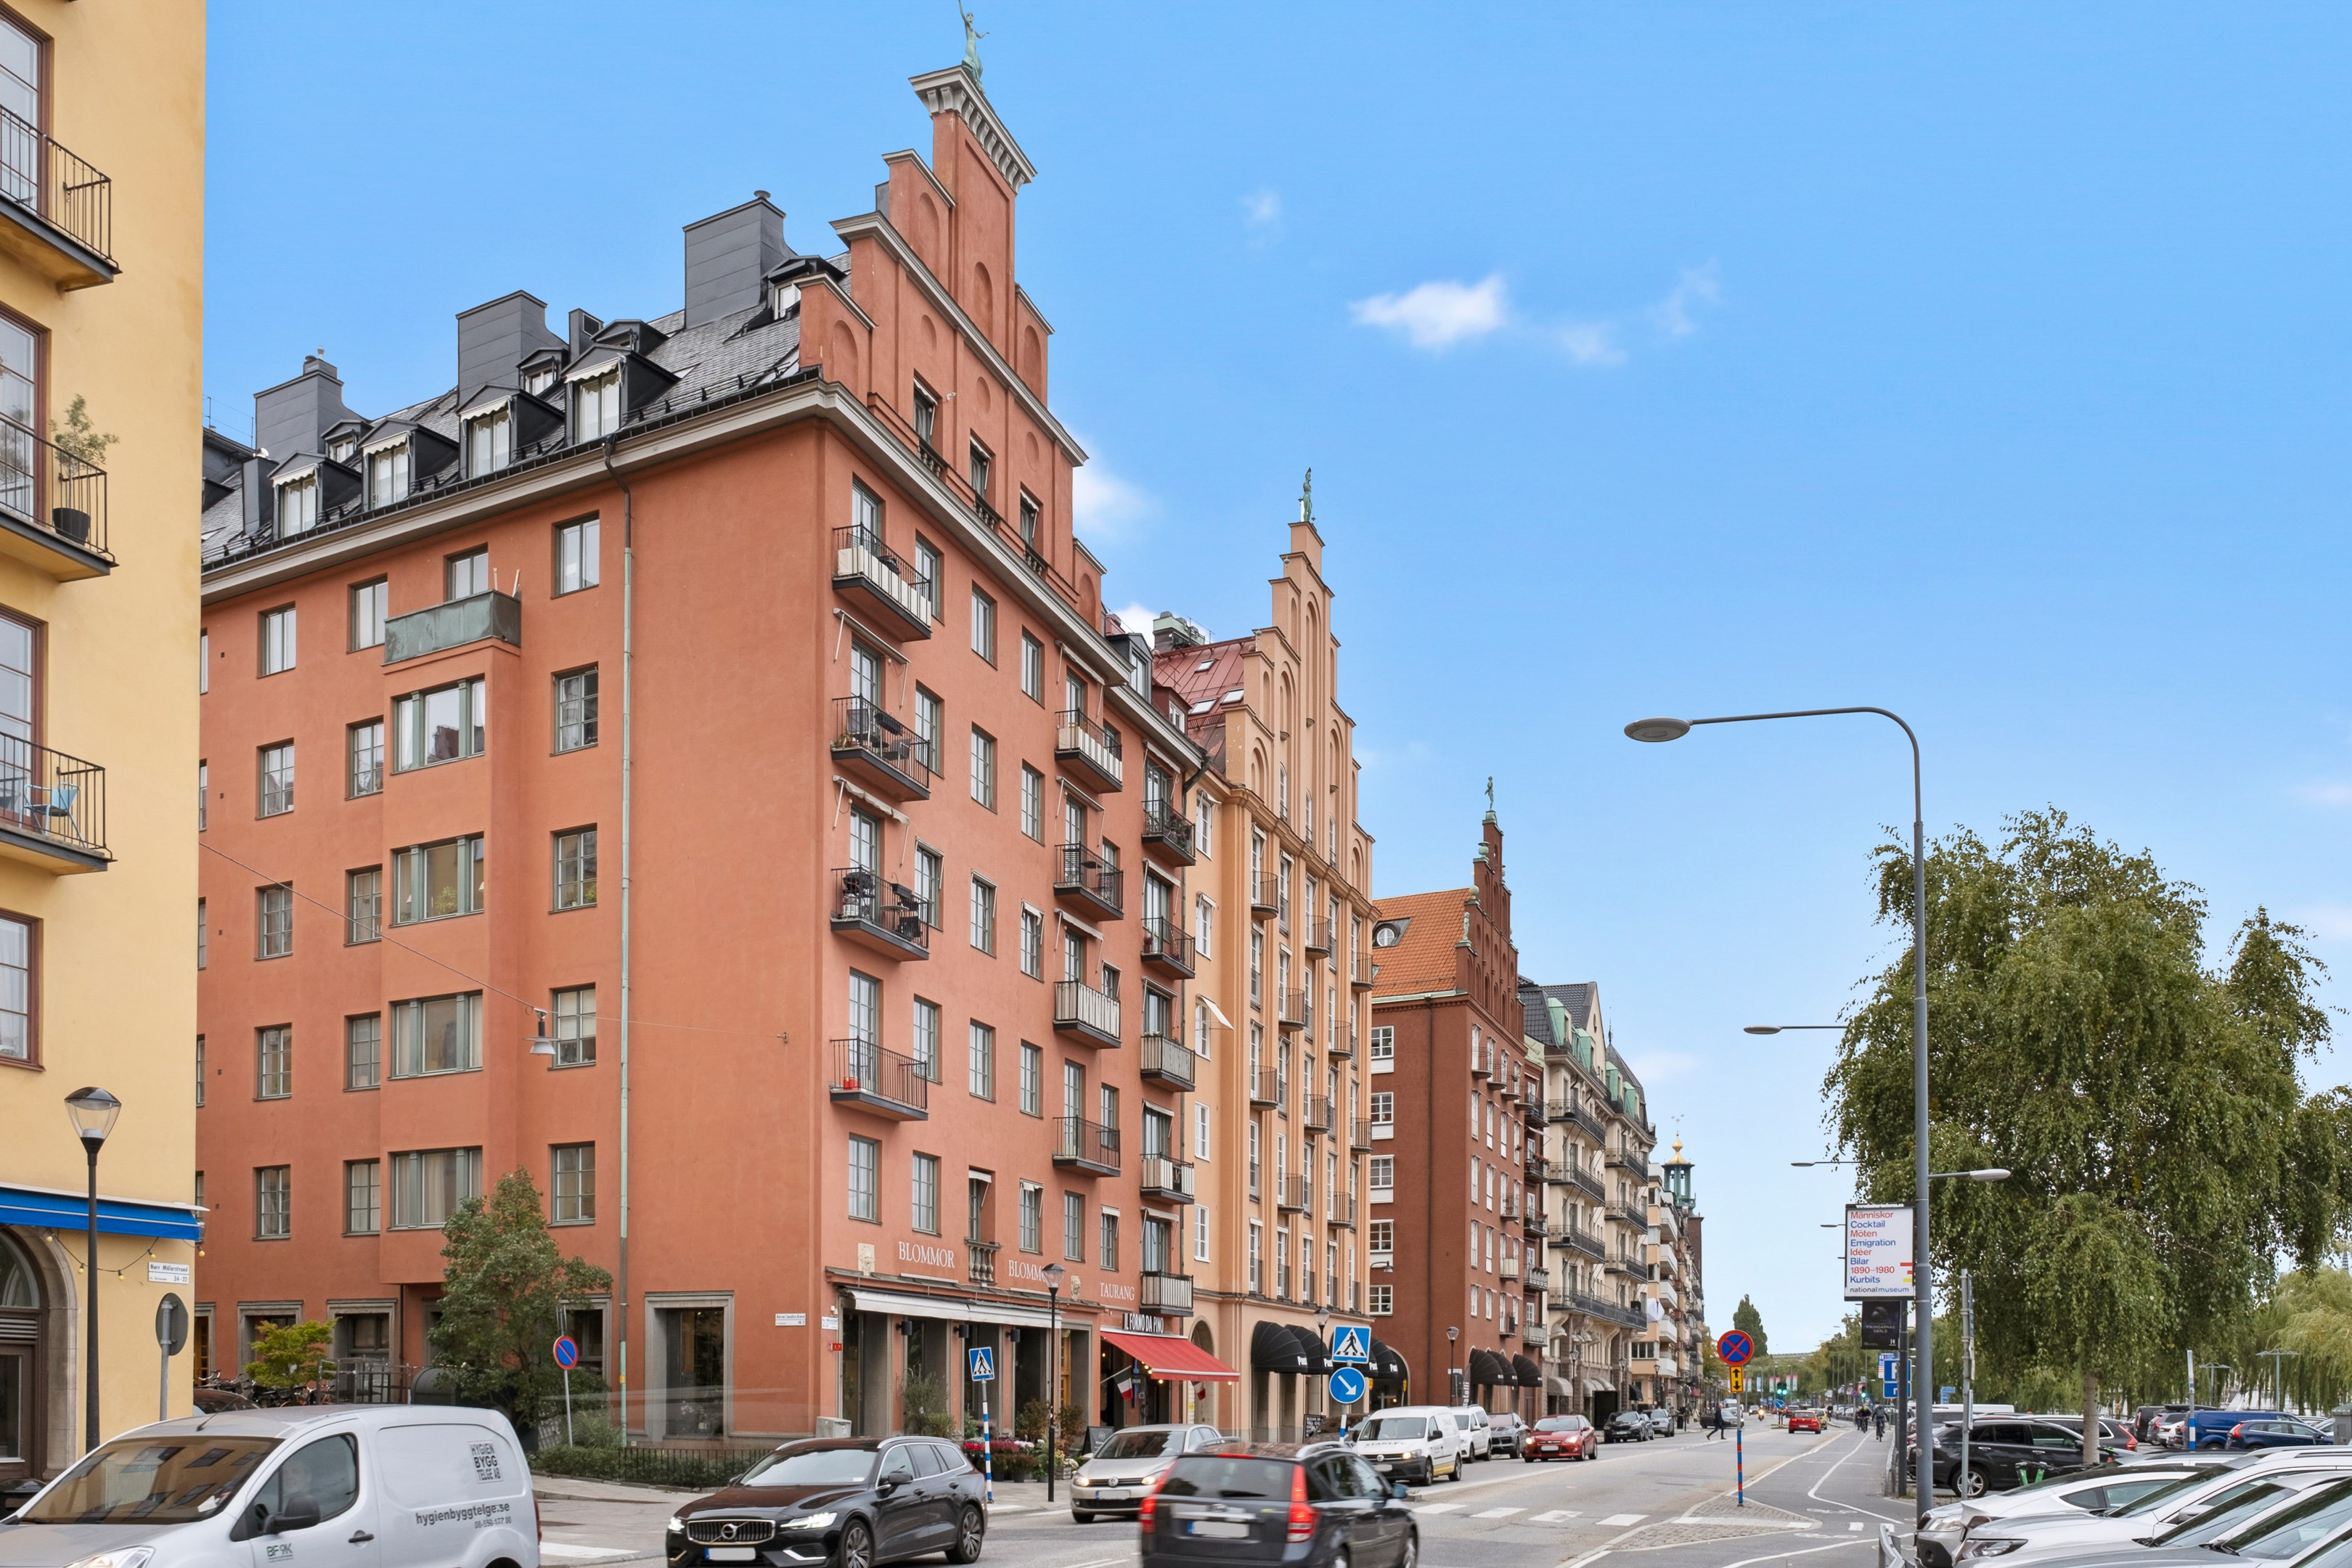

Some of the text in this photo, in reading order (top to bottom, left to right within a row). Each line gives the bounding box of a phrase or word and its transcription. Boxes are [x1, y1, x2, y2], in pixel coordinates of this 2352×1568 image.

[1850, 1238, 1896, 1248] Emigration
[898, 1241, 955, 1268] BLOMMOR
[1100, 1282, 1135, 1301] TAURANG
[1124, 1312, 1164, 1334] IL FORNO DA PINO
[470, 1442, 495, 1456] HYGIEN
[473, 1455, 498, 1469] BYGG
[476, 1467, 501, 1481] TELGE AB
[415, 1503, 510, 1527] hygienbyggtelge.se
